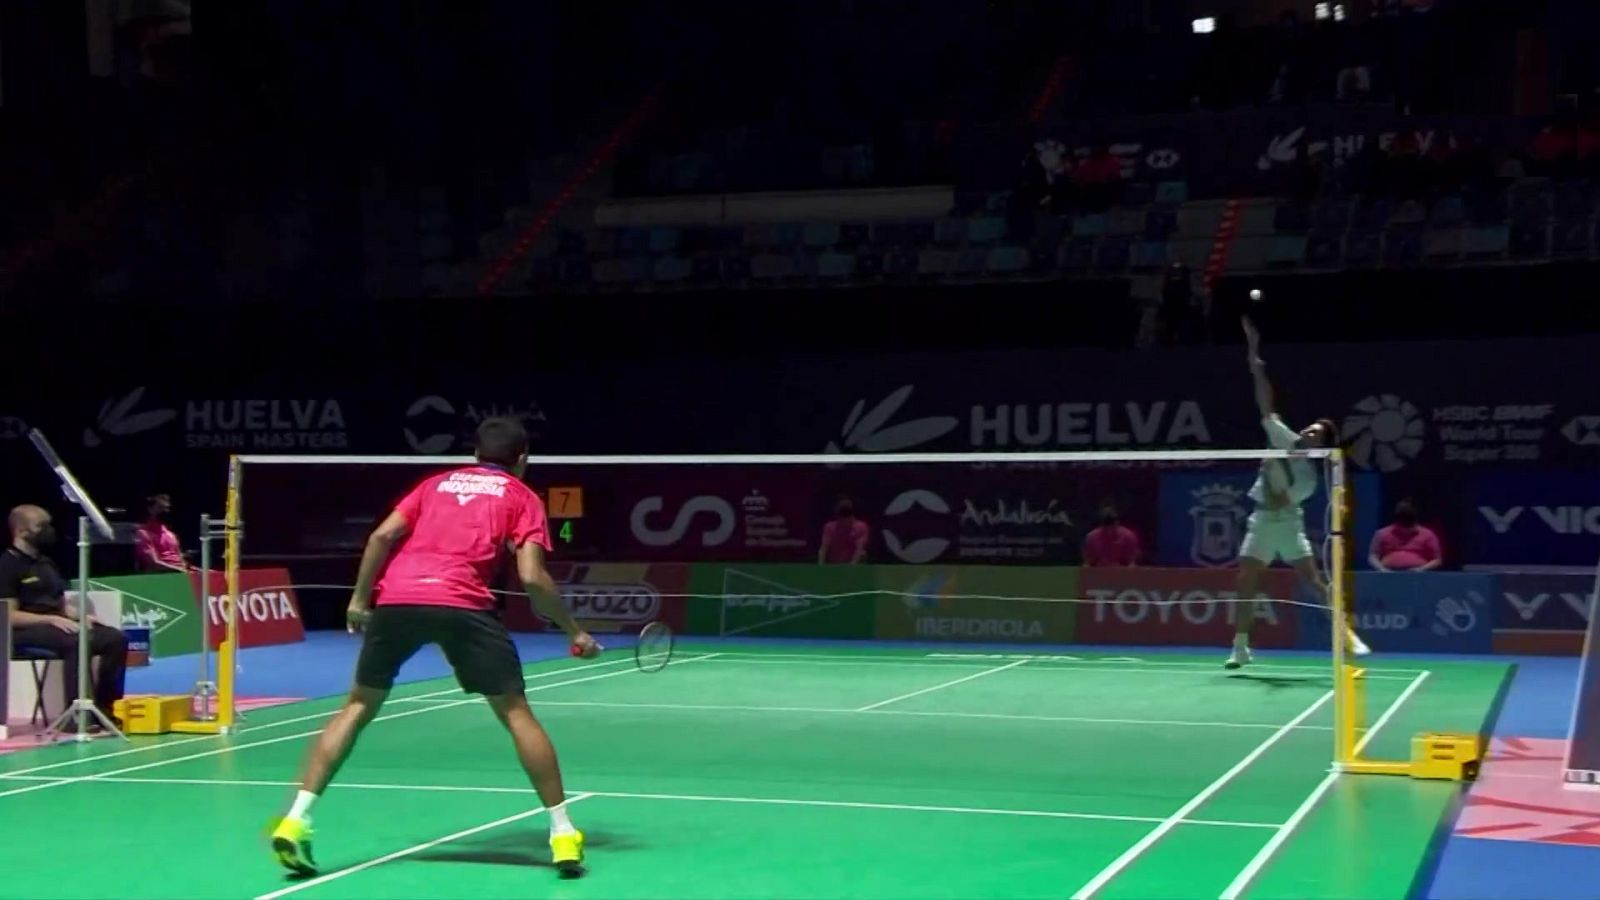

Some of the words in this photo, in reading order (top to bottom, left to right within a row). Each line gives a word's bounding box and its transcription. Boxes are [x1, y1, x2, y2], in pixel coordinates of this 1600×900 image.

[185, 398, 347, 431] HUELVA
[970, 401, 1212, 446] HUELVA
[185, 432, 246, 448] SPAIN
[252, 432, 349, 448] MASTERS
[560, 491, 571, 514] 7
[559, 519, 574, 543] 4
[571, 589, 654, 614] POZO
[1085, 588, 1280, 626] TOYOTA
[916, 616, 1044, 637] IBERDROLA
